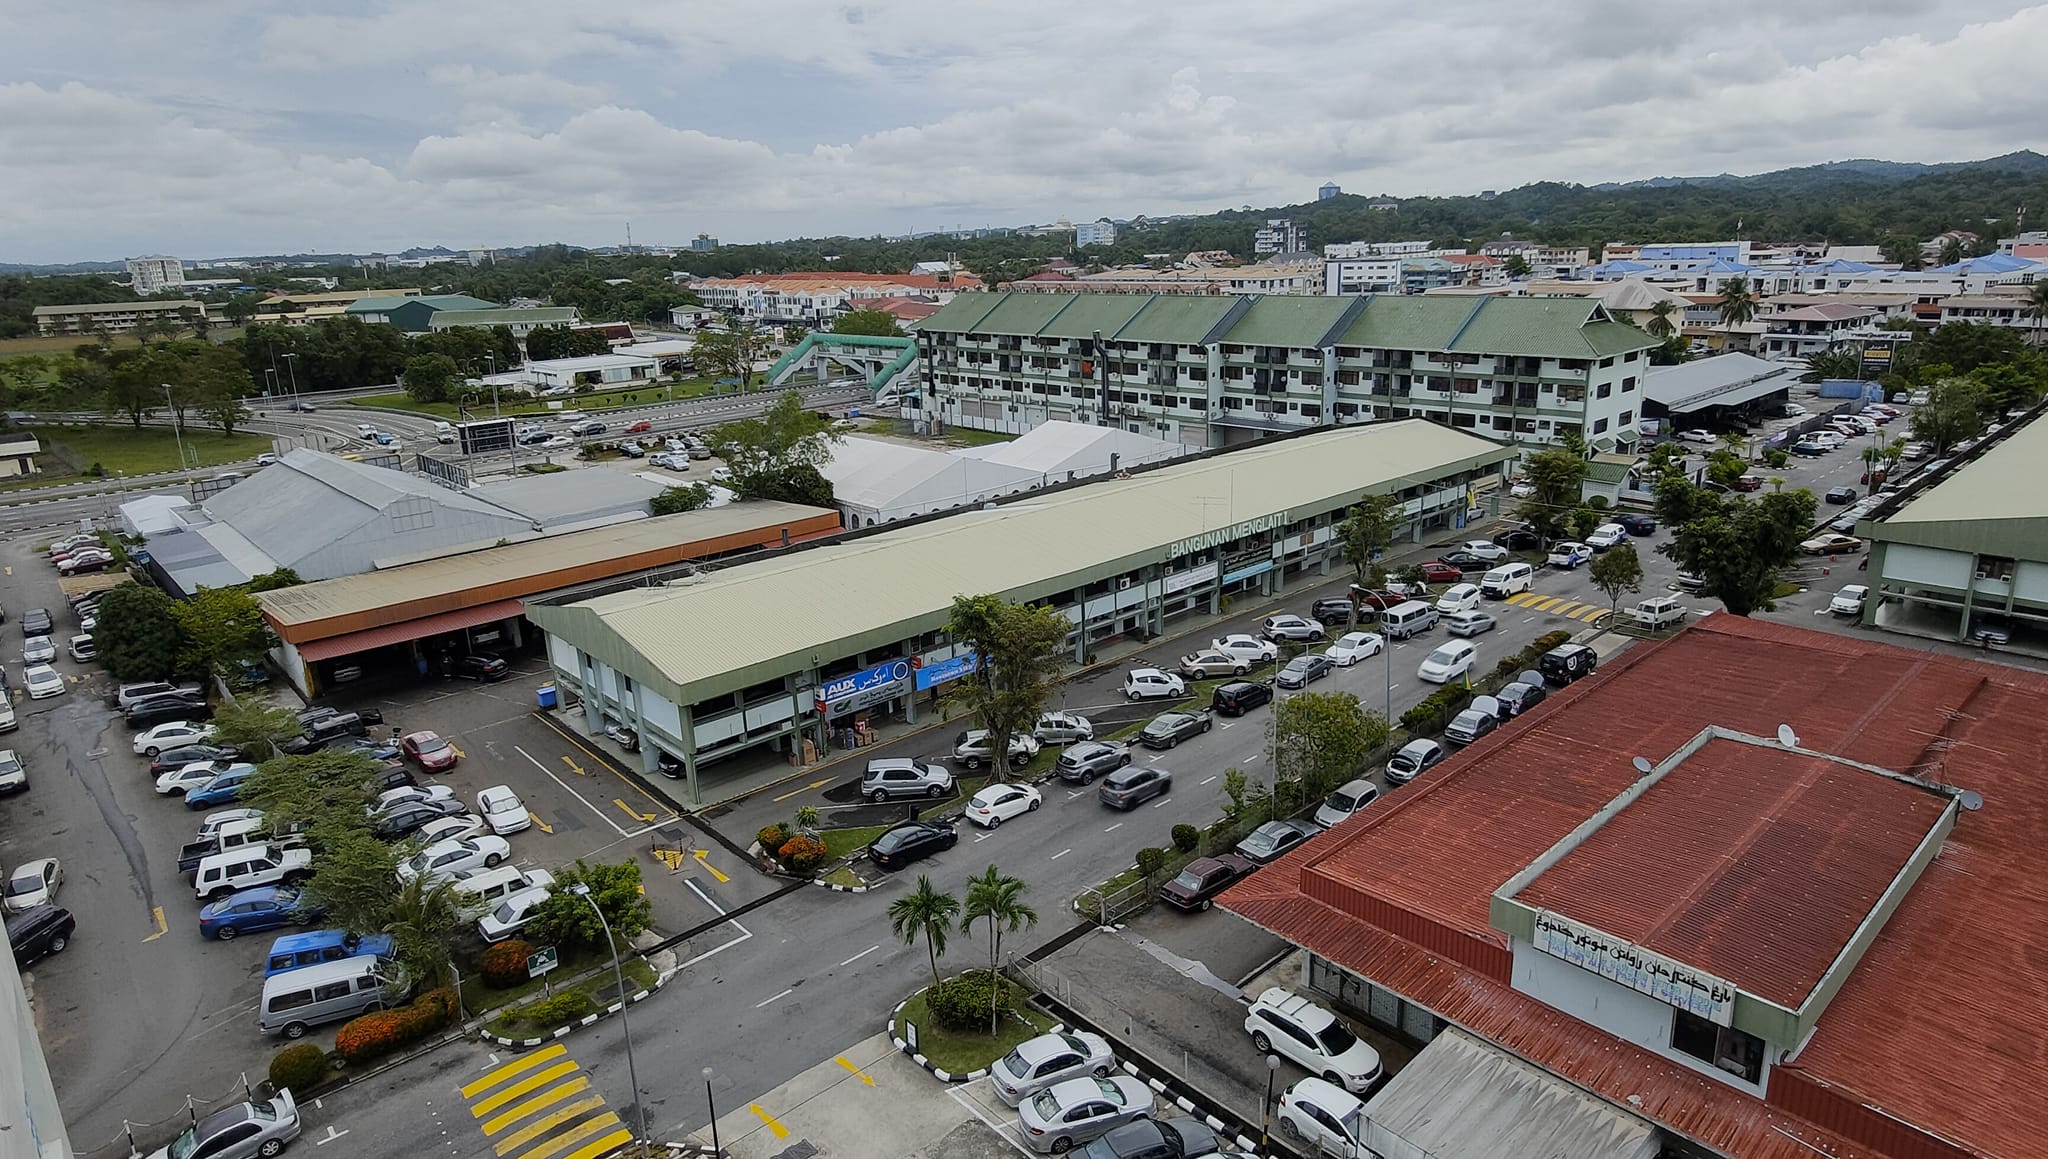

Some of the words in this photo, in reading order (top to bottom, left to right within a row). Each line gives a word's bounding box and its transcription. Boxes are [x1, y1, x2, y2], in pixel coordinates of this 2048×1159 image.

[1171, 527, 1230, 559] BANGUNAN
[1232, 512, 1283, 541] MENGLAIT
[827, 678, 856, 696] AUX
